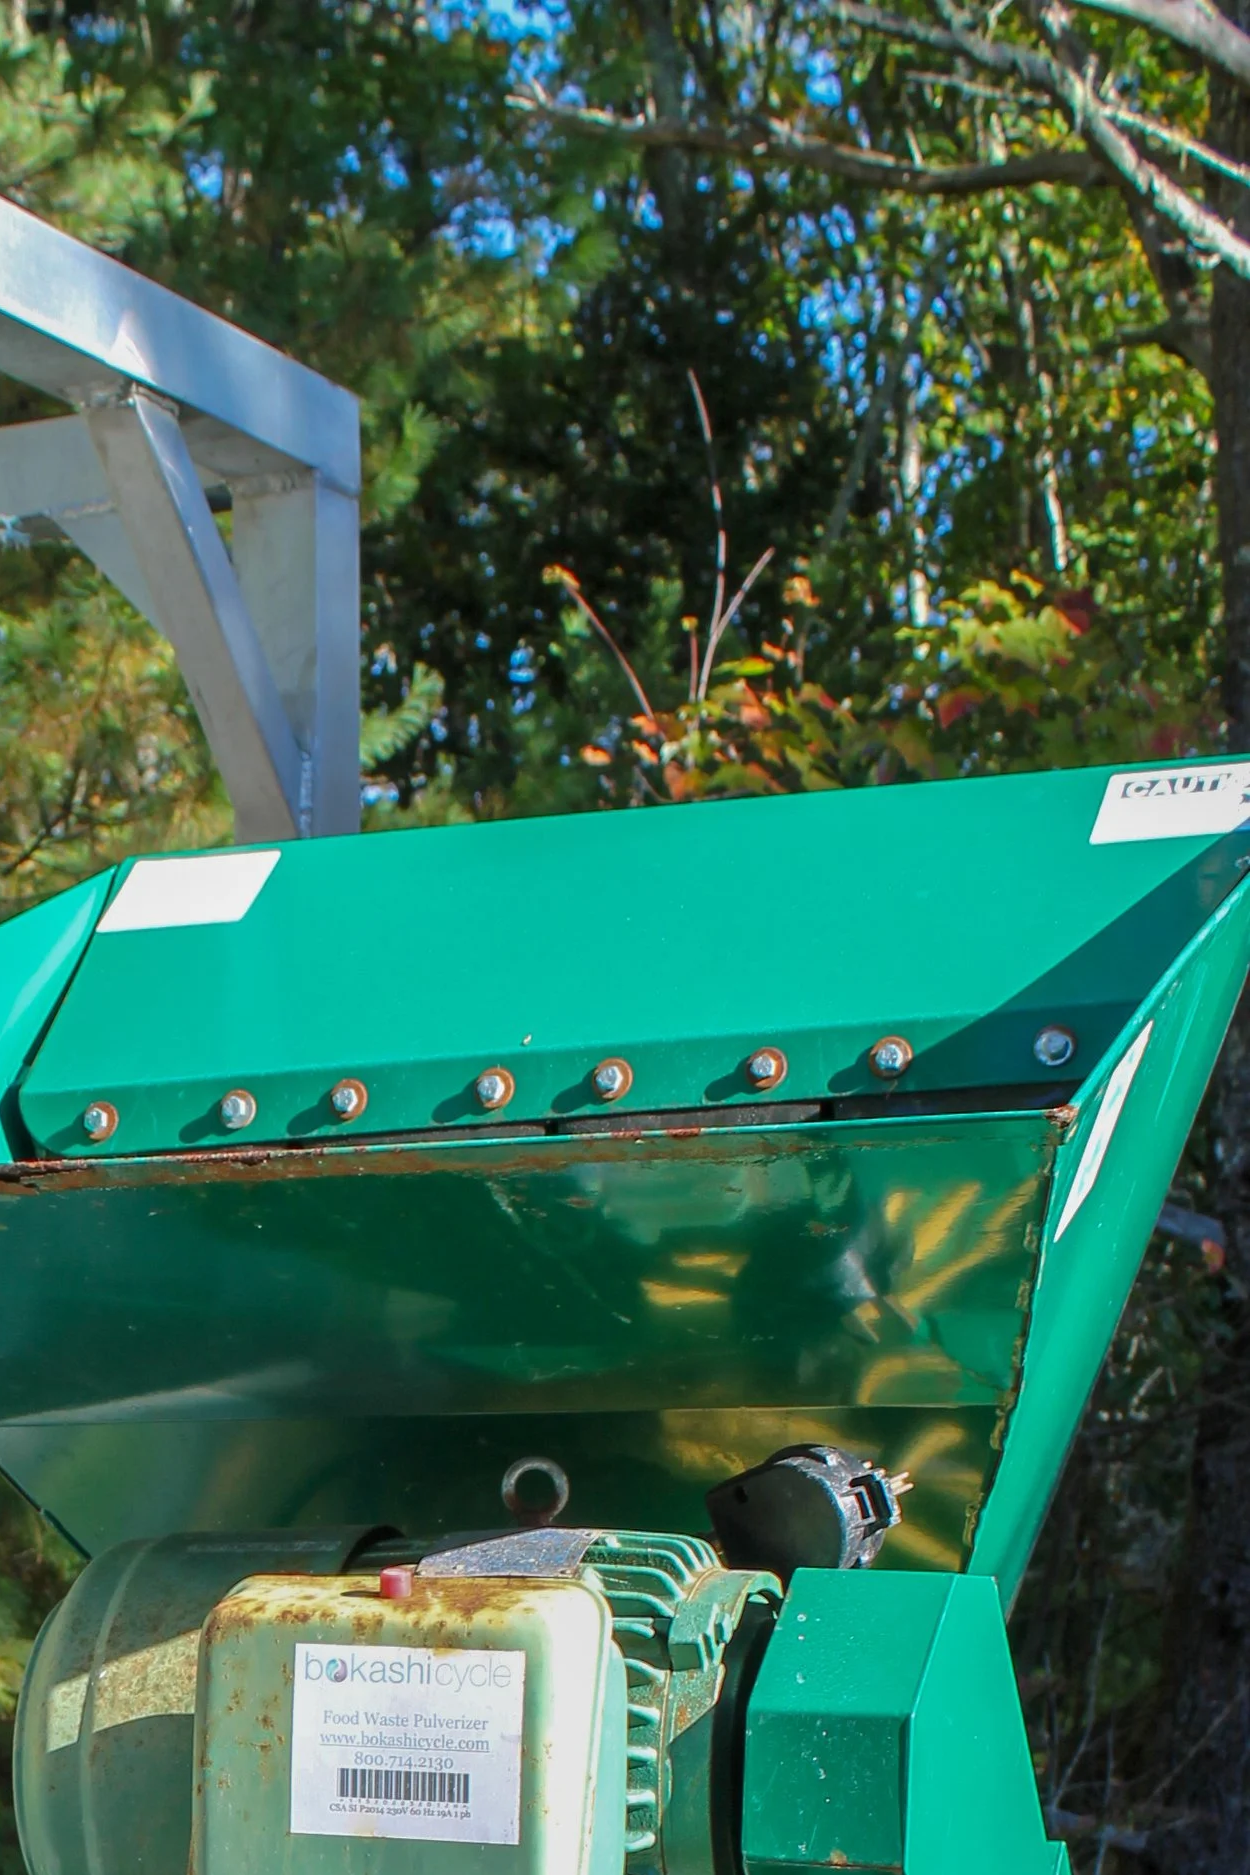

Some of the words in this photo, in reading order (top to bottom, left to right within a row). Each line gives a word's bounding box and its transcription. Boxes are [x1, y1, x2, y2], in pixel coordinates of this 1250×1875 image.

[304, 1651, 512, 1693] bokashicycle
[323, 1710, 359, 1726] Food
[364, 1712, 409, 1728] Waste
[413, 1713, 489, 1731] Pulverizer
[320, 1730, 490, 1752] www.bokashicycle.com
[354, 1751, 455, 1772] 800.714.2130
[329, 1803, 347, 1812] CSA
[410, 1807, 421, 1816] 60
